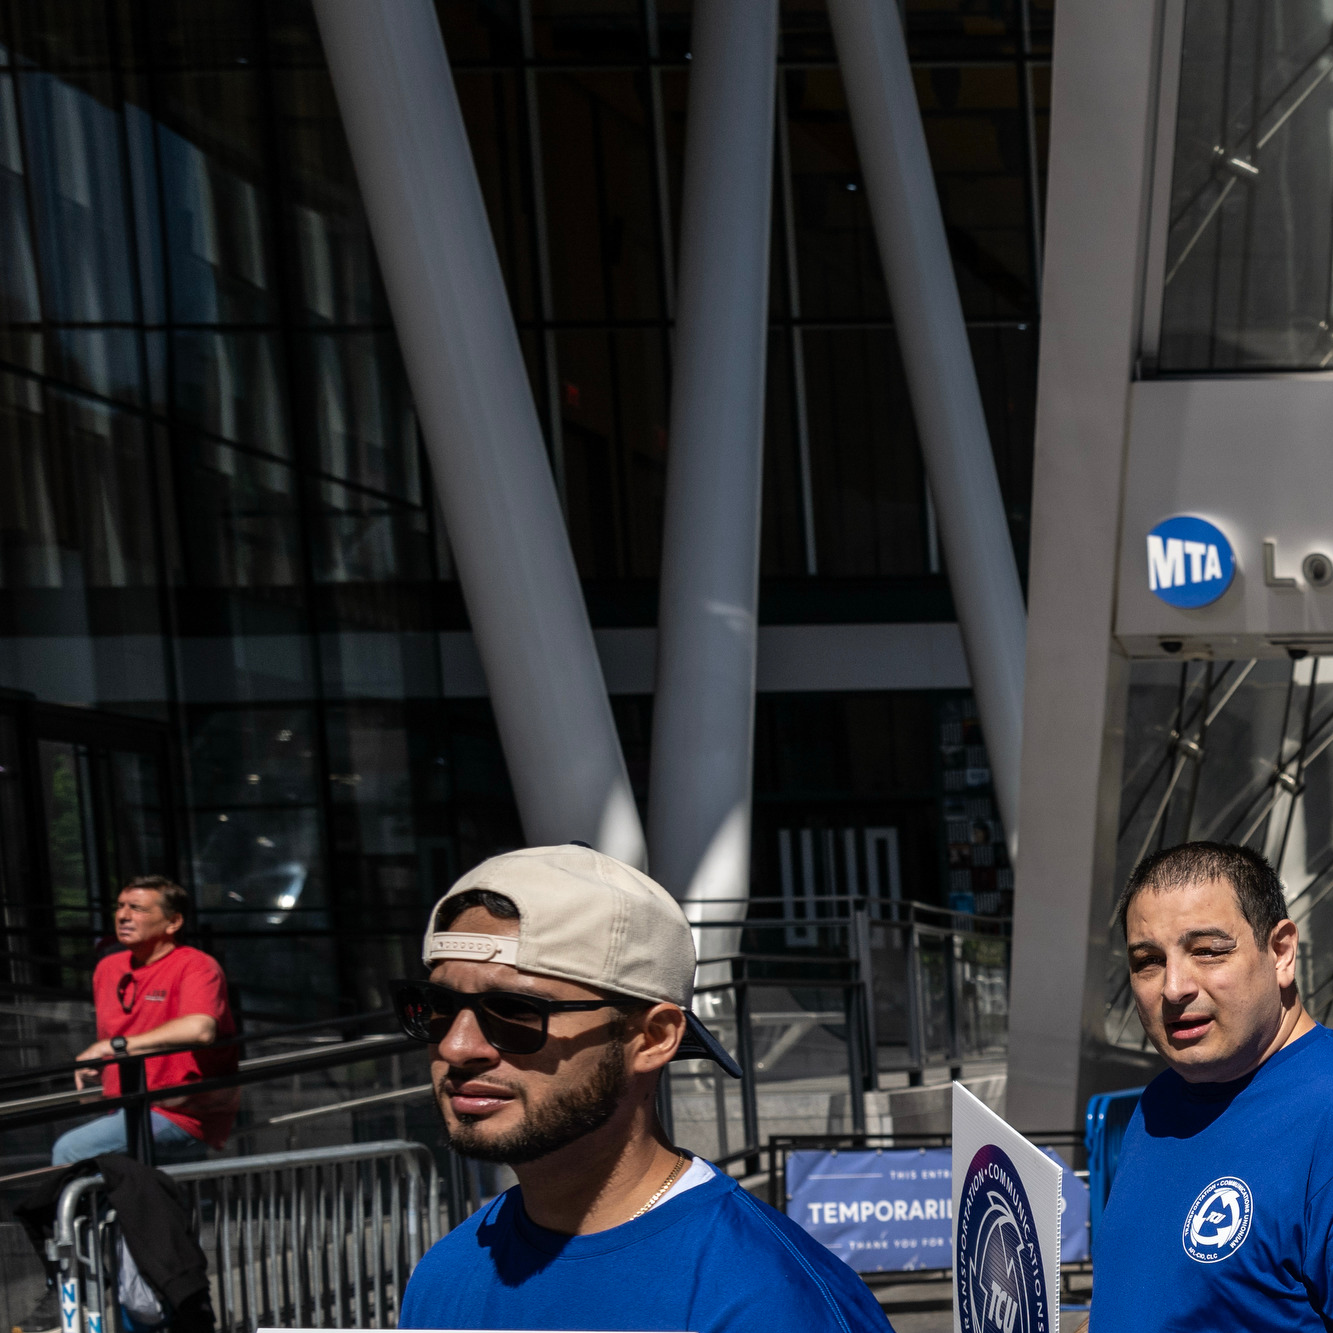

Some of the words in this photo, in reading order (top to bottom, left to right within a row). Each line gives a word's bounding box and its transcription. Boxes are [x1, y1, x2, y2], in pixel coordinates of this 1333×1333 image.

[1146, 534, 1223, 591] MTA
[921, 1168, 952, 1180] ENTR
[808, 1199, 952, 1224] TEMPORARIL
[1206, 1211, 1226, 1224] TCU
[894, 1238, 917, 1249] YOU
[921, 1237, 944, 1248] FOR
[988, 1162, 1045, 1333] COMMUNICATIONS
